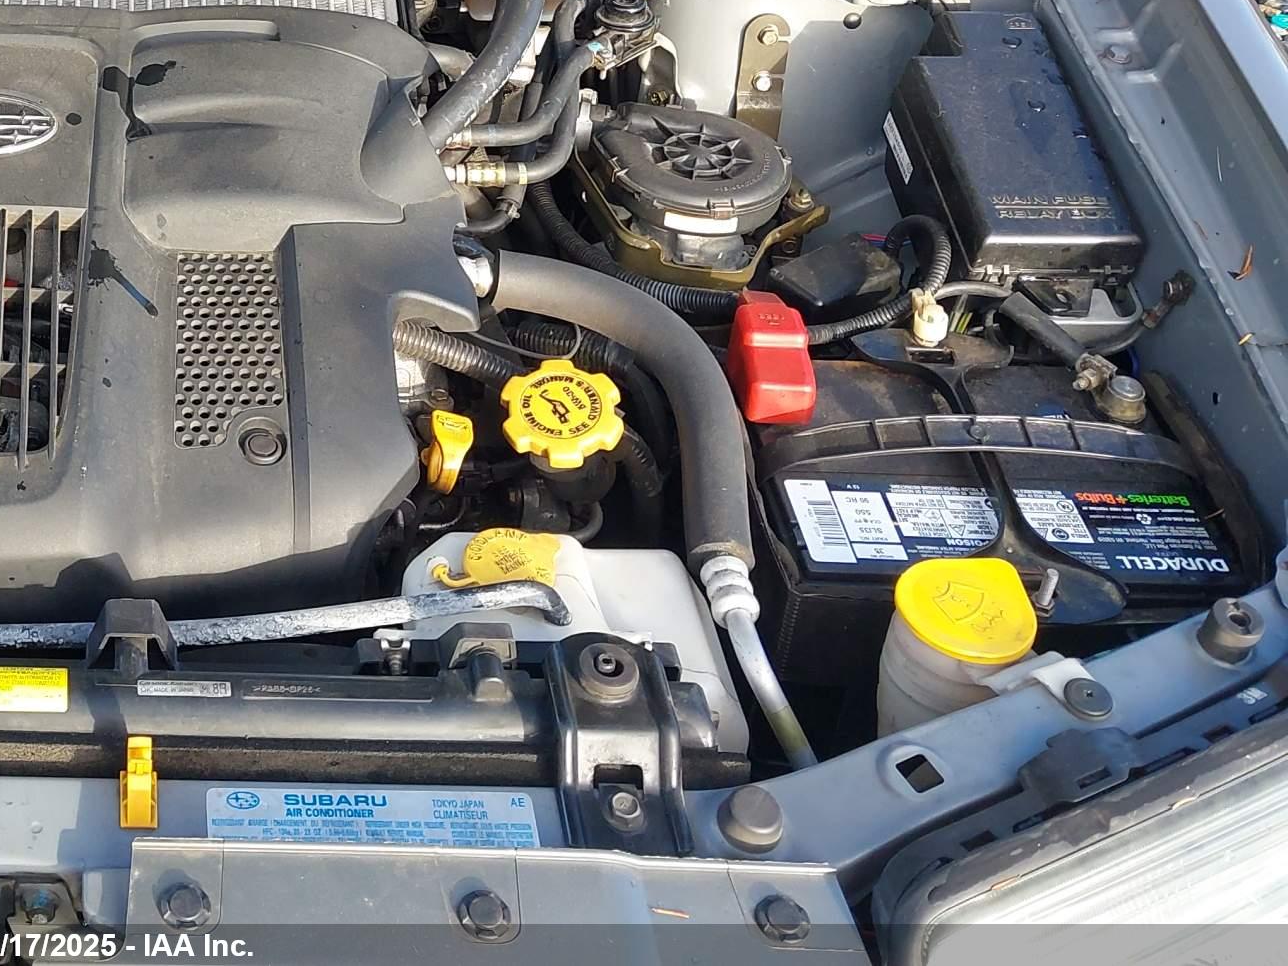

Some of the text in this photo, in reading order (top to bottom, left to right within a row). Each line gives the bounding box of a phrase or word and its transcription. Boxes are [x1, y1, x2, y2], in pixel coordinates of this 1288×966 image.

[988, 194, 1048, 205] MAIN
[522, 394, 563, 436] ENGINE OIL
[568, 421, 590, 435] SEE
[1115, 555, 1230, 573] DURACELL
[284, 793, 526, 809] SUBARU TOKYO JAPAN AE
[285, 808, 489, 820] AIR CONDITIONER CLIMATISEUR
